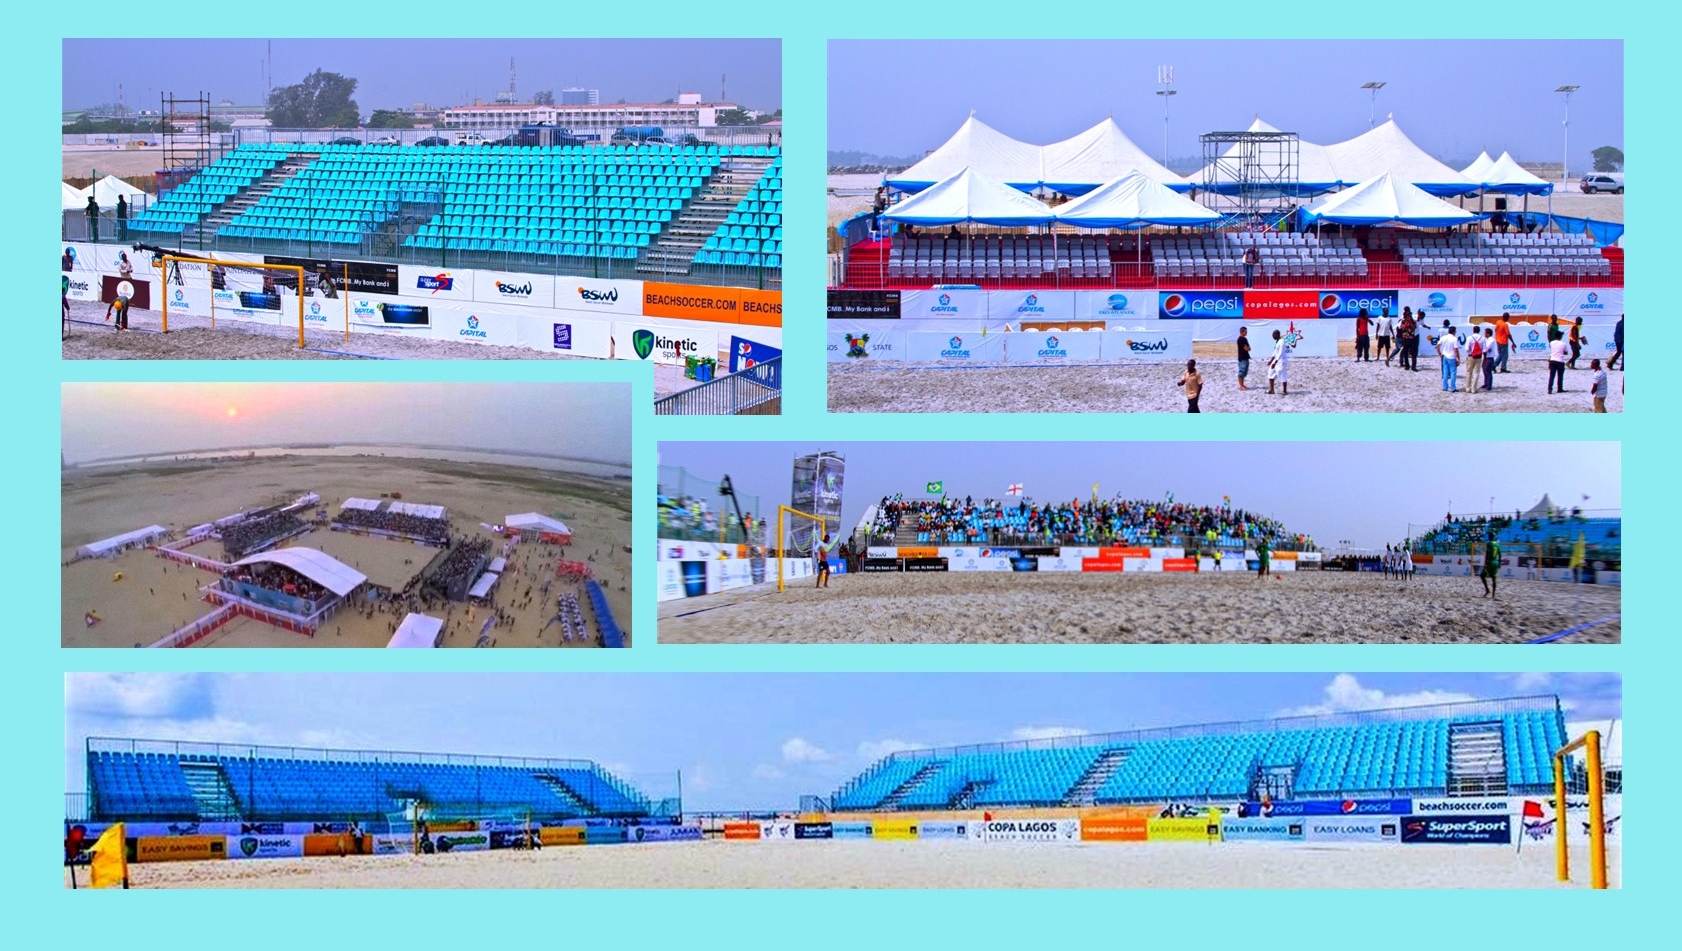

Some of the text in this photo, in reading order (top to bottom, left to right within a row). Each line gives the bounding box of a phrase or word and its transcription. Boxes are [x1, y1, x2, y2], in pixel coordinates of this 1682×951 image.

[165, 261, 202, 271] OUDATION
[69, 279, 89, 291] kinetic
[646, 293, 737, 310] BEACHSOCCER.COM
[1191, 296, 1238, 313] pepsi
[1245, 301, 1317, 309] copalagos.com
[1346, 295, 1393, 312] pepsi
[743, 301, 782, 314] BEACHS
[460, 329, 487, 338] CAPITAL
[655, 335, 698, 352] kinetic
[662, 350, 686, 360] spots
[1275, 804, 1304, 814] pepsi
[1358, 802, 1391, 812] pepsi
[1419, 801, 1508, 811] beachsoccer.com
[988, 822, 1057, 832] COPA LAGOS
[1223, 825, 1287, 834] EASY BANKING
[1314, 825, 1376, 834] EASY LOANS
[1428, 820, 1508, 833] SuperSport
[260, 838, 291, 847] kinetic
[142, 844, 167, 854] EASY
